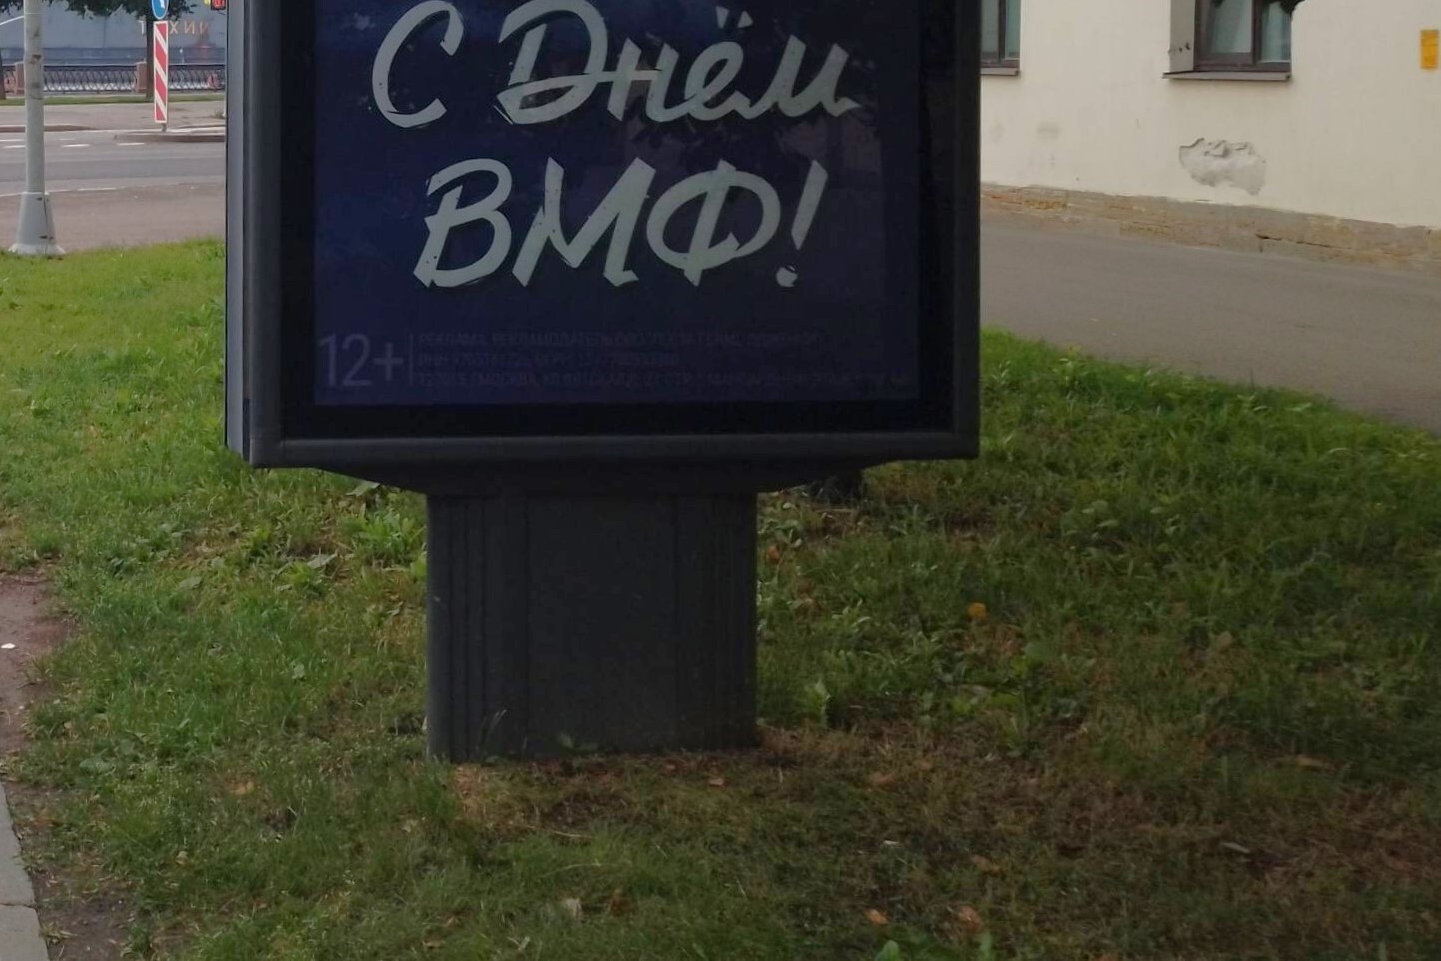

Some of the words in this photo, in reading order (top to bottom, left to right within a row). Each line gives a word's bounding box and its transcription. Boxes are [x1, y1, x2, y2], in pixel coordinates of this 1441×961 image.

[371, 0, 465, 129] С
[413, 156, 829, 288] ВМФ!
[319, 333, 405, 389] 12+
